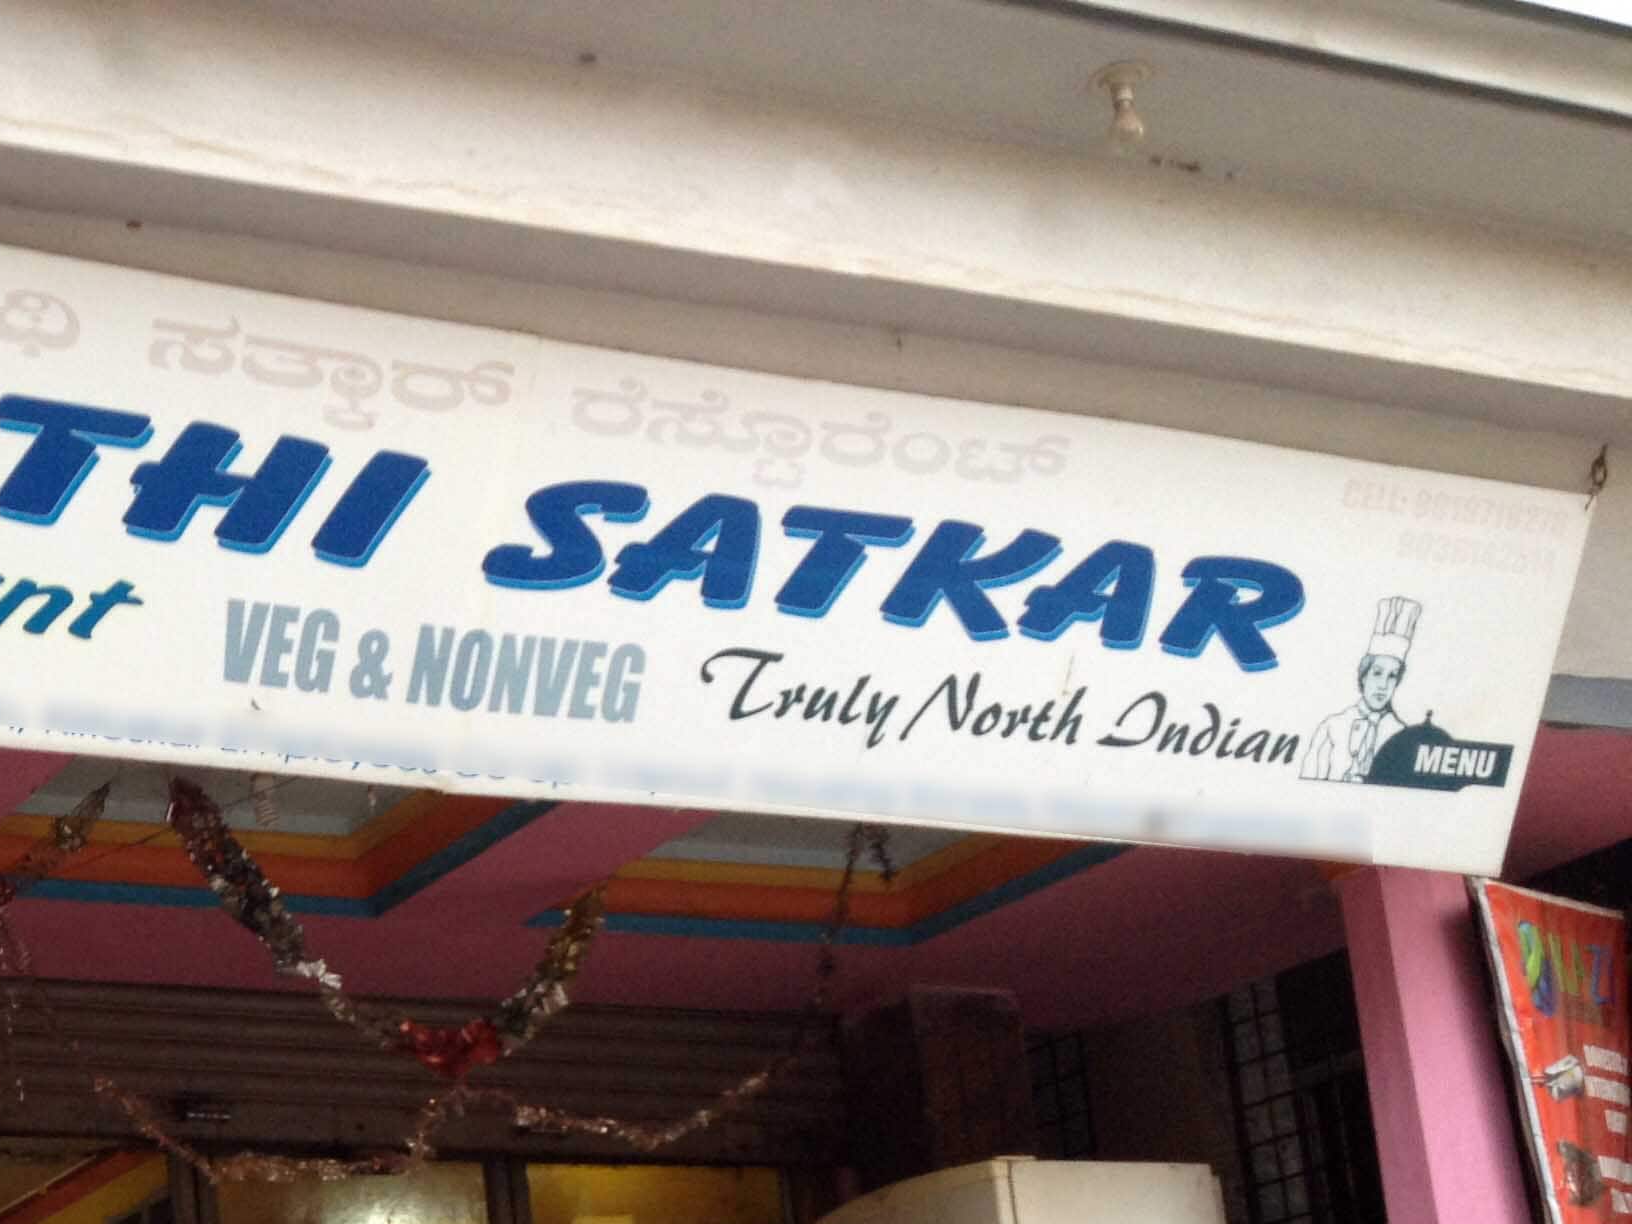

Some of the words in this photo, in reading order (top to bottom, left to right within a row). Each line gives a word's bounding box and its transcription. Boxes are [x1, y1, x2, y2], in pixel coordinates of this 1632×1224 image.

[481, 479, 1304, 671] SATKAR
[223, 598, 340, 694] VEG
[349, 629, 393, 701] &
[405, 623, 646, 723] NONVEG
[700, 647, 901, 749] Truly
[899, 672, 1088, 745] North
[1096, 691, 1300, 764] Indian
[1414, 744, 1497, 778] MENU
